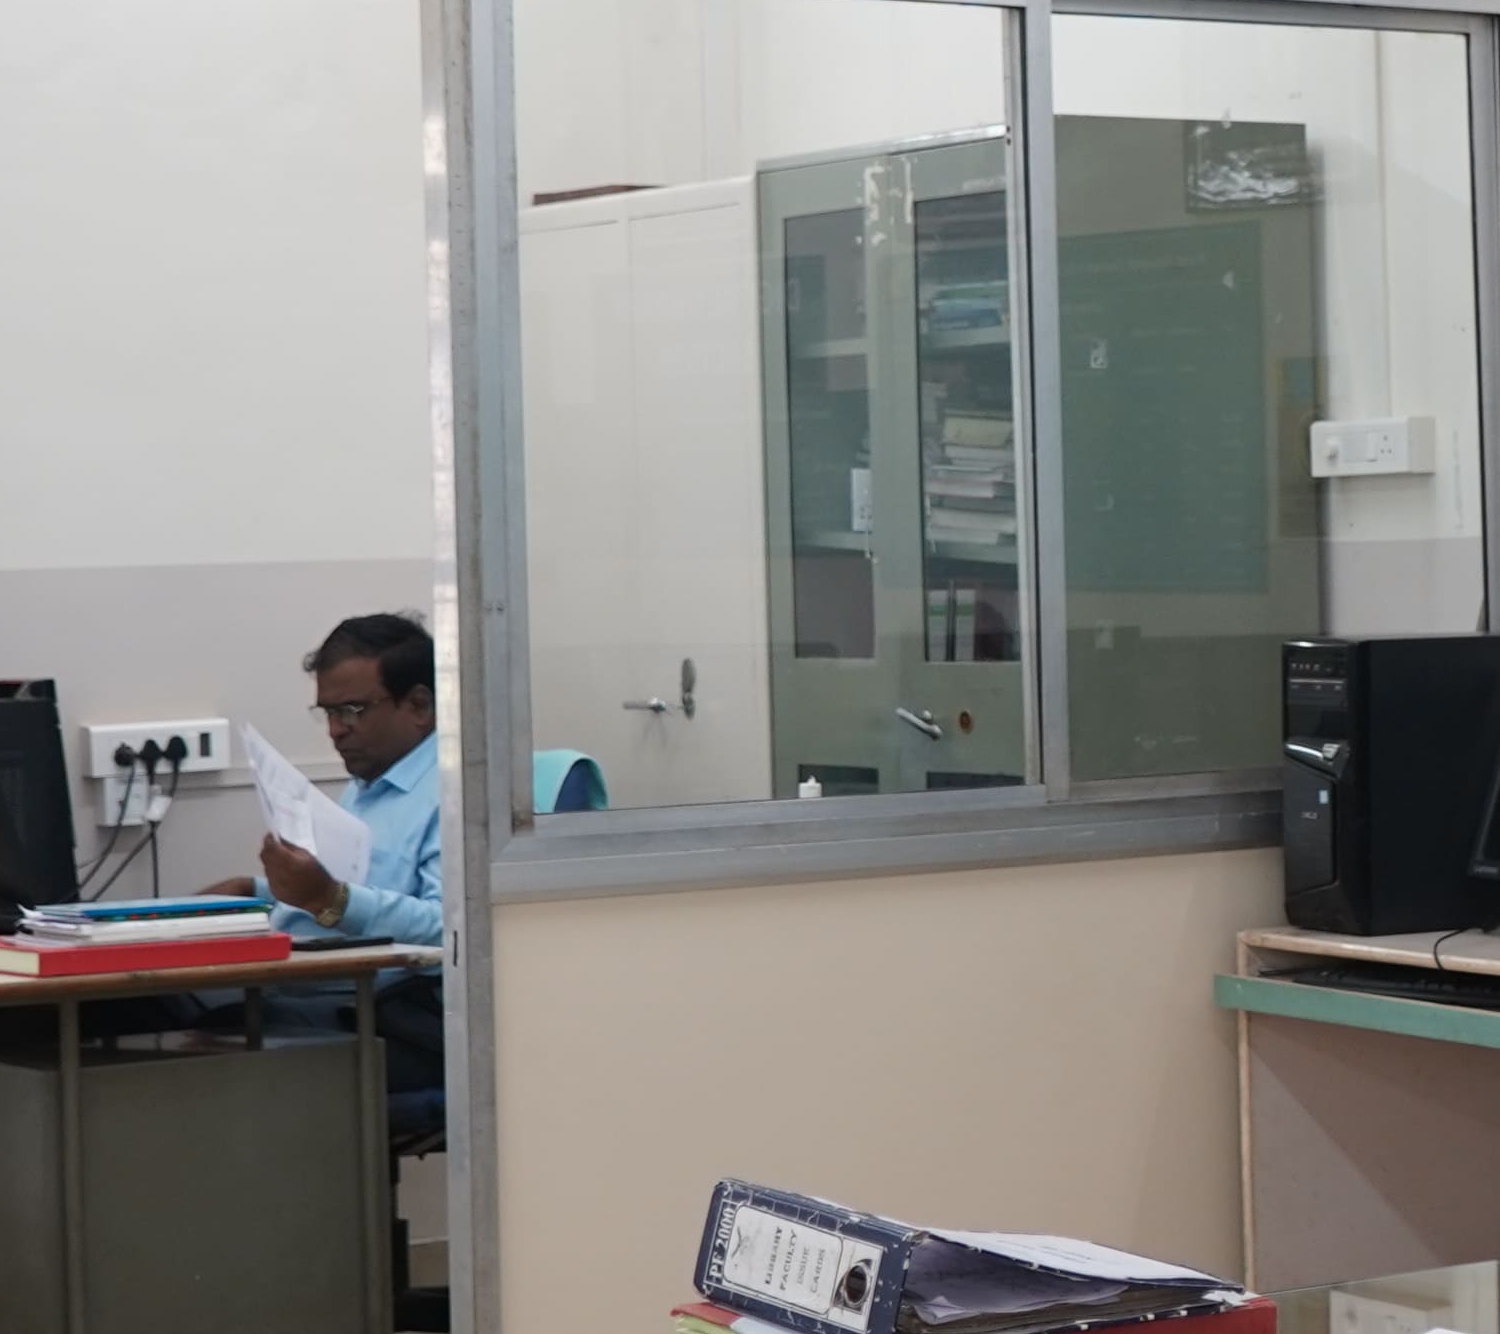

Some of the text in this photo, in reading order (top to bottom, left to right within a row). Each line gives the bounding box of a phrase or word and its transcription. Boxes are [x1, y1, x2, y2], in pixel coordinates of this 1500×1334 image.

[709, 1207, 737, 1281] PF 2000
[779, 1229, 798, 1292] FACULTY
